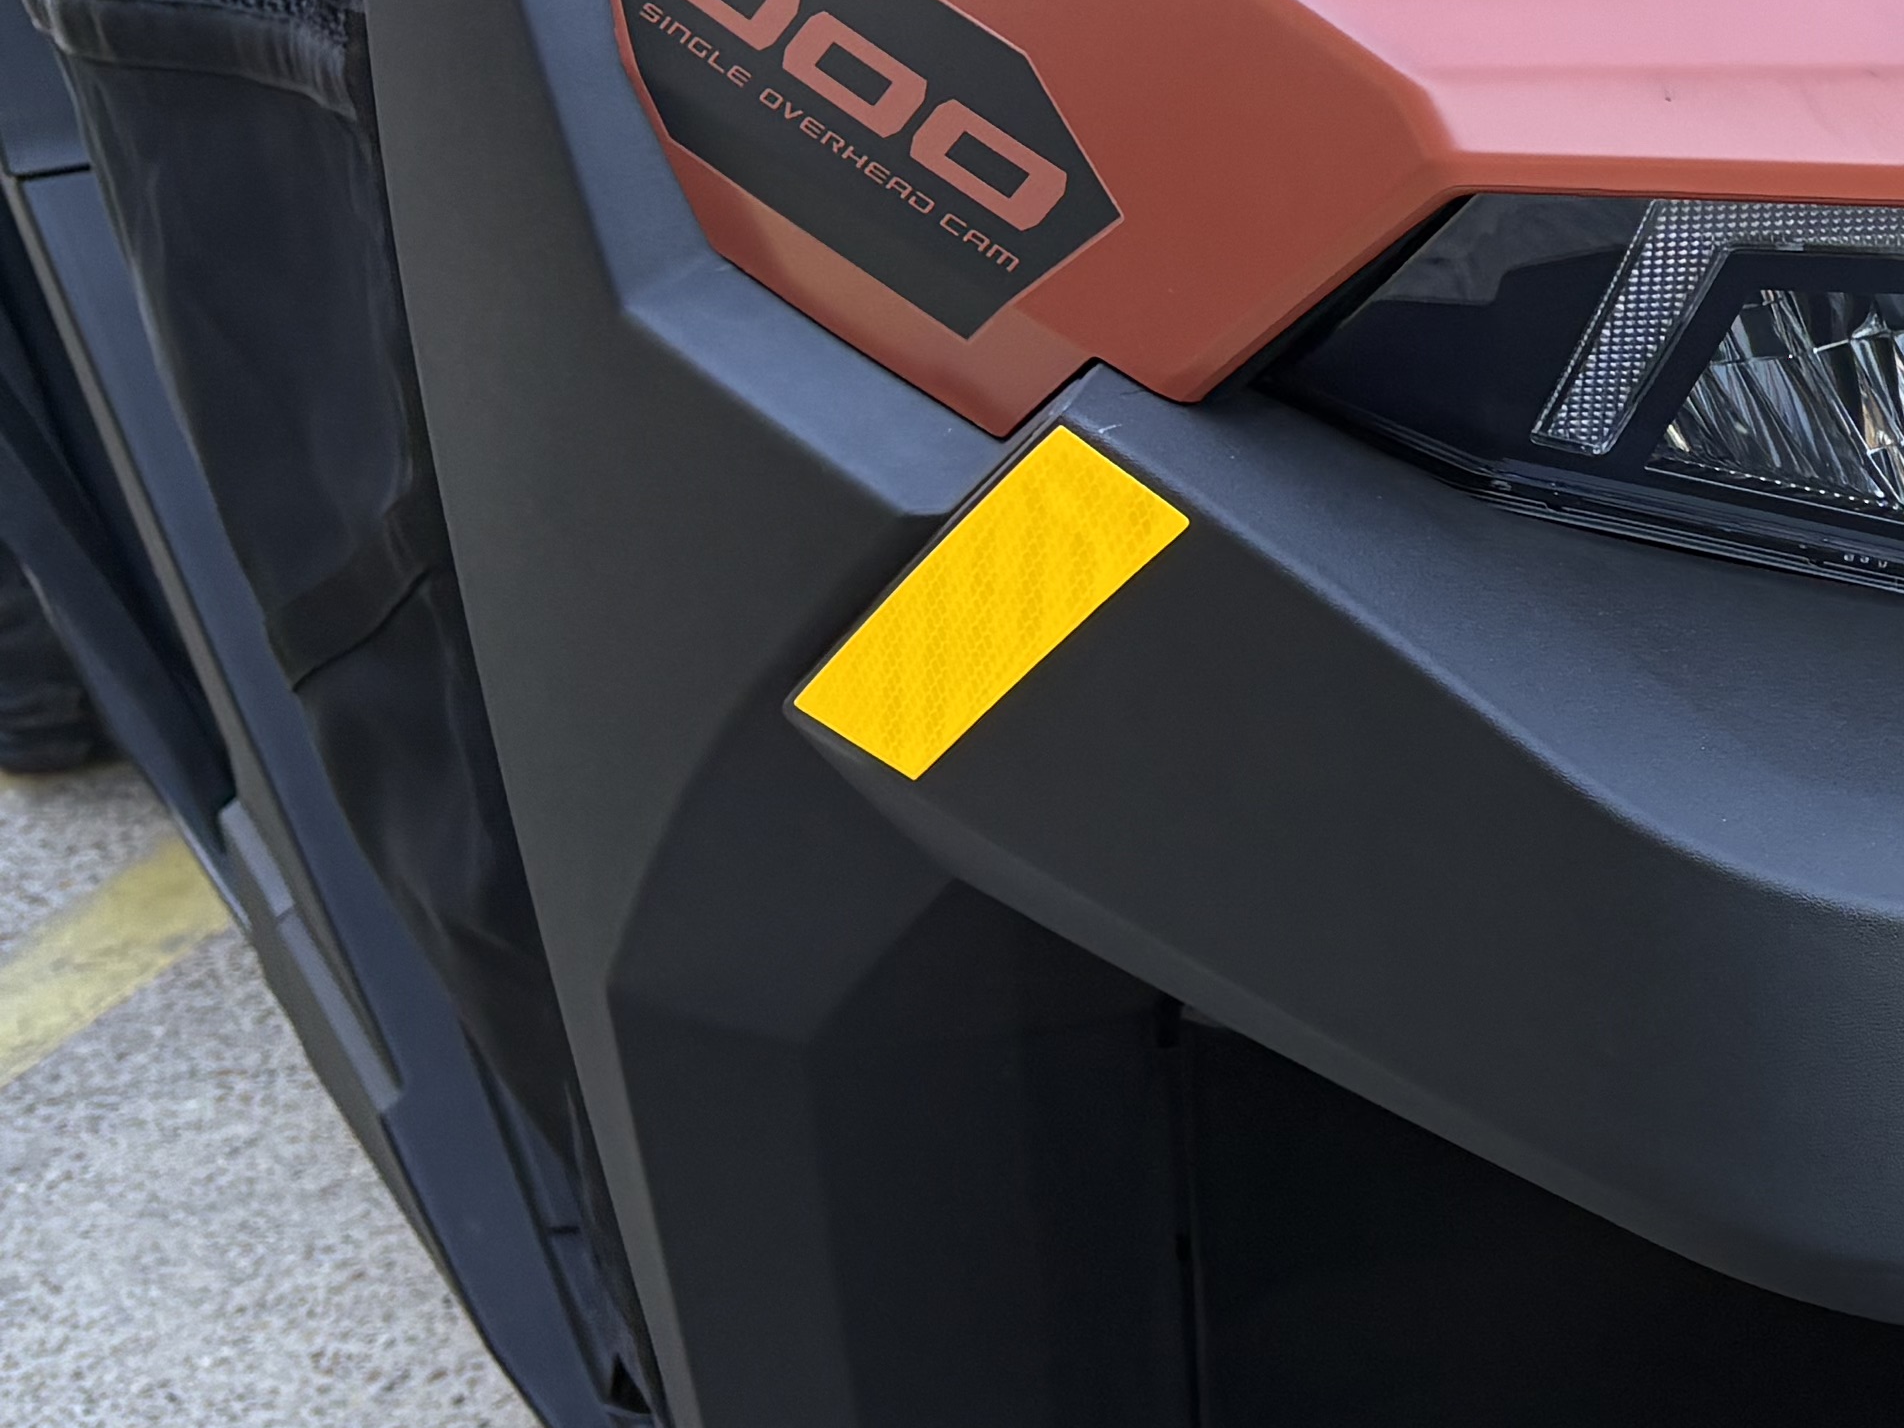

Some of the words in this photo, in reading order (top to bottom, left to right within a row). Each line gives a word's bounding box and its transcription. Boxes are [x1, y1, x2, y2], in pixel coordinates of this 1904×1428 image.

[639, 1, 752, 88] SINGLE
[759, 86, 935, 215] OVERHEAD
[939, 212, 1020, 273] CAM
